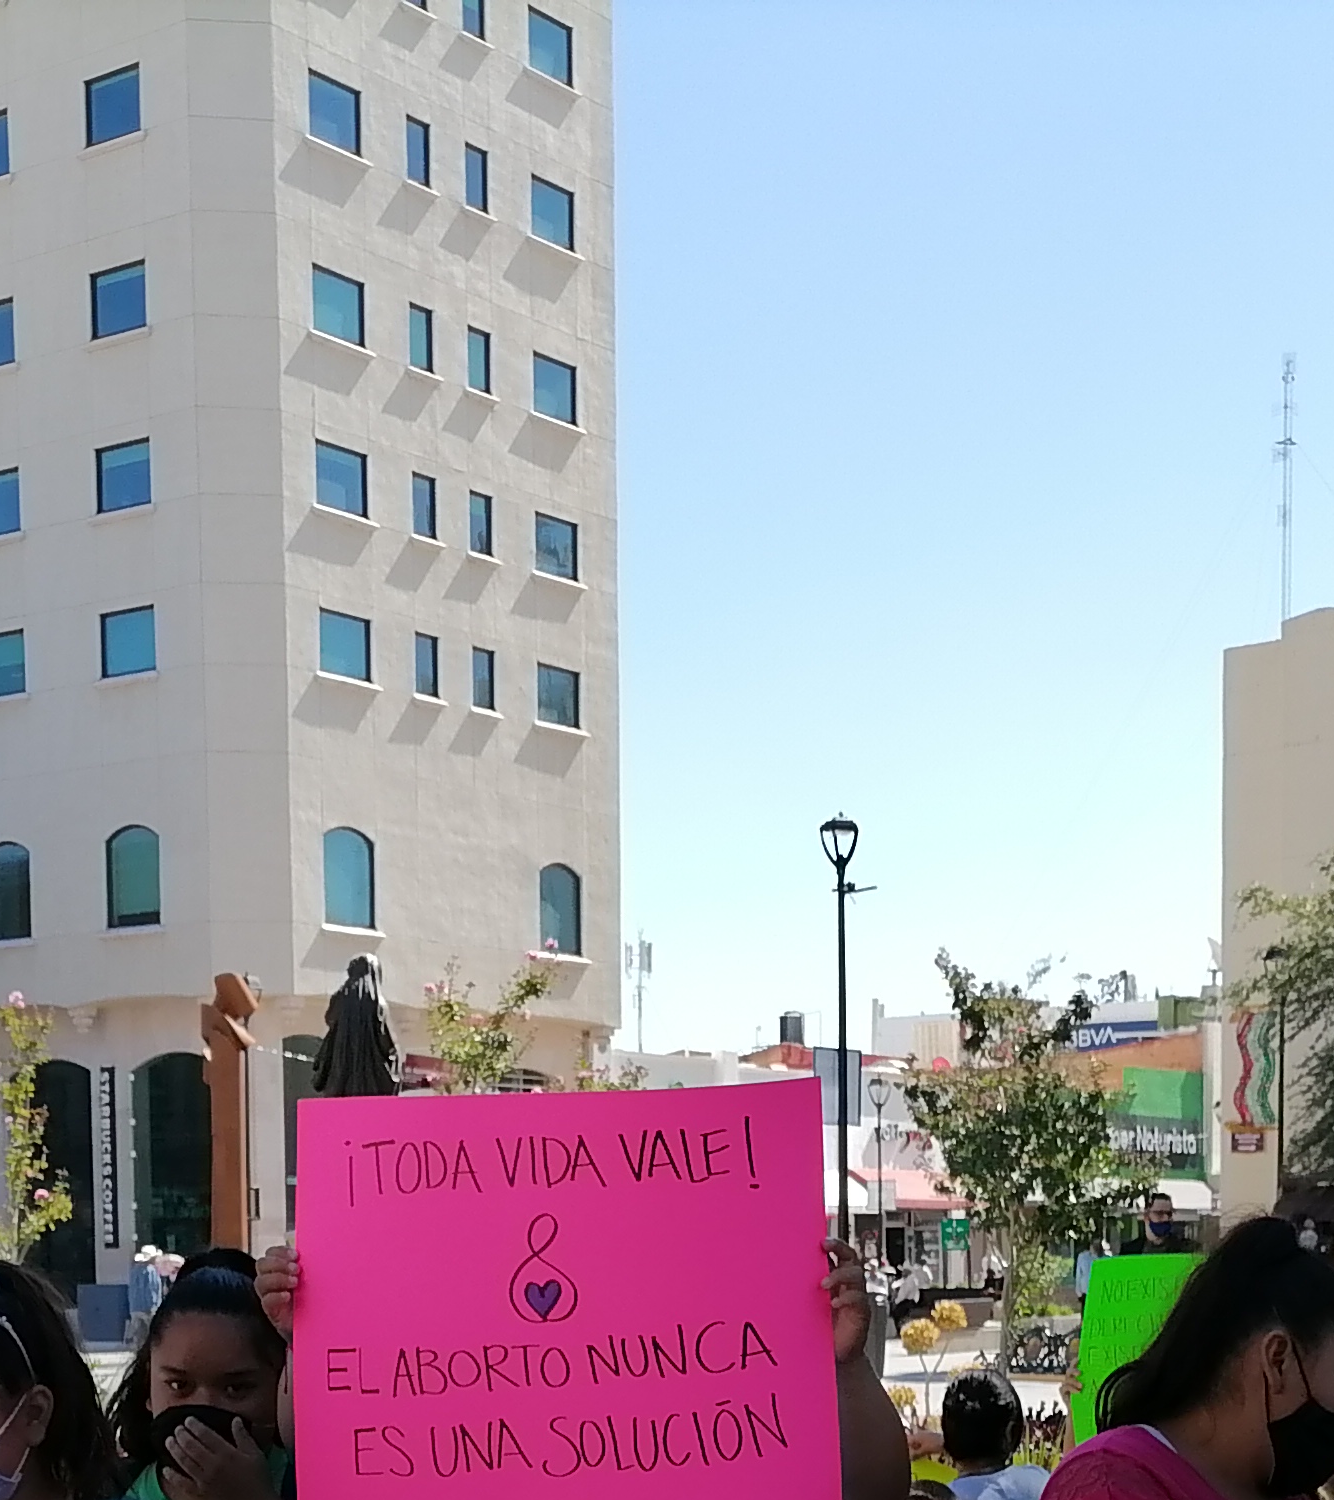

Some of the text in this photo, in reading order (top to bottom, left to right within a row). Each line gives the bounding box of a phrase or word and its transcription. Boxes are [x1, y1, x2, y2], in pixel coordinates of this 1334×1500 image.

[100, 1070, 114, 1244] STARBUCKS COFFEE
[344, 1115, 761, 1208] ¡TODA VIDA VALE!
[1136, 1124, 1197, 1154] Naturista
[327, 1320, 779, 1398] EL ABORTO NUNCA
[353, 1392, 789, 1478] ES UNA SOLUCIÓN
